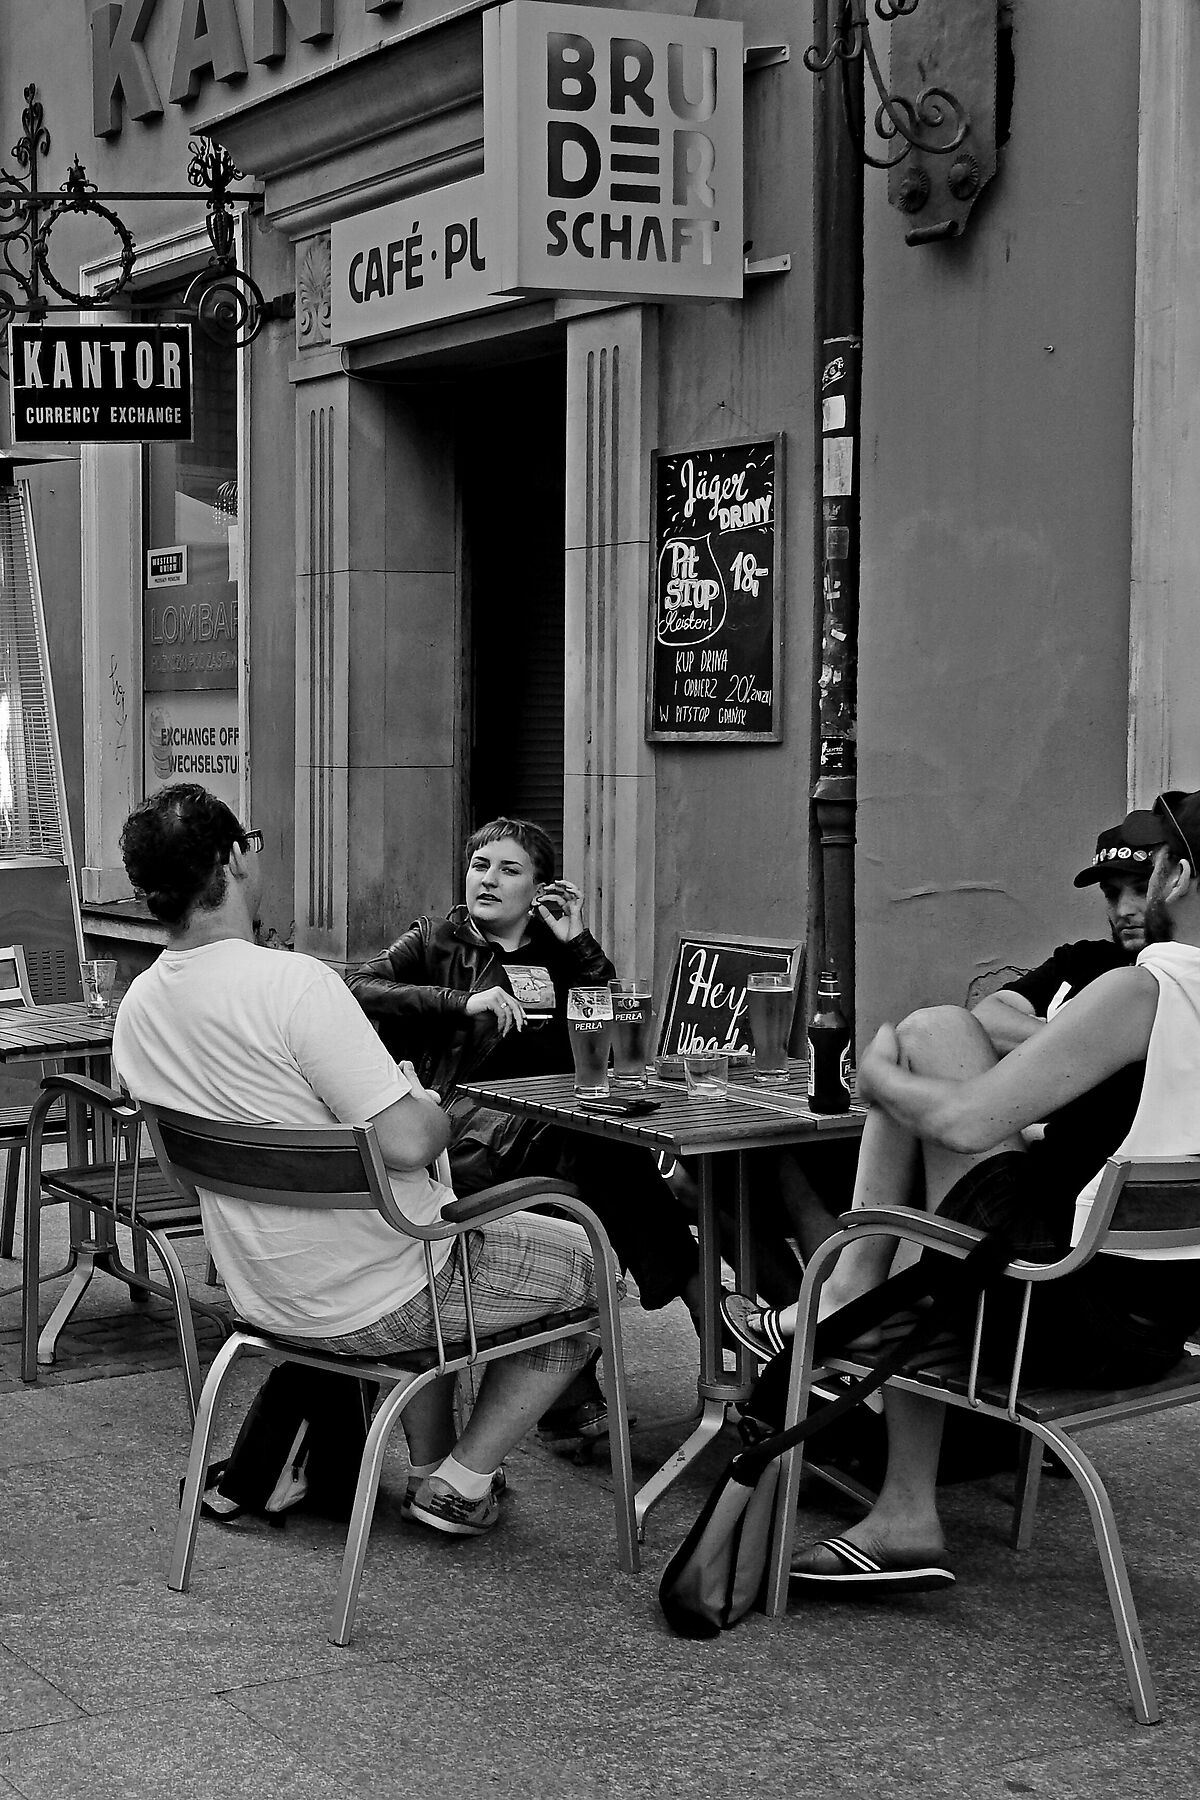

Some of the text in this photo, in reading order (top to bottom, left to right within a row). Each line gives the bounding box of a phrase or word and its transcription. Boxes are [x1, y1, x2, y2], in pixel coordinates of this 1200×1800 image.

[547, 31, 717, 123] BRU
[547, 120, 715, 208] DER
[546, 209, 720, 266] SCHAFT
[349, 220, 424, 304] CAFÉ
[22, 340, 182, 390] KANTOR
[26, 406, 182, 424] CURRENCY EXCHANGE
[680, 458, 749, 521] Jäger
[718, 494, 772, 530] DRINY
[664, 578, 720, 611] STOP
[675, 648, 729, 674] KUP DRINA
[725, 674, 756, 703] 20%
[660, 705, 669, 722] W
[675, 705, 711, 723] PITSTOP
[161, 727, 216, 746] EXCHANGE
[169, 755, 240, 773] WECHSELSTU
[687, 949, 748, 1041] Hey
[575, 1021, 603, 1031] PERŁA
[615, 1012, 643, 1021] PERŁA
